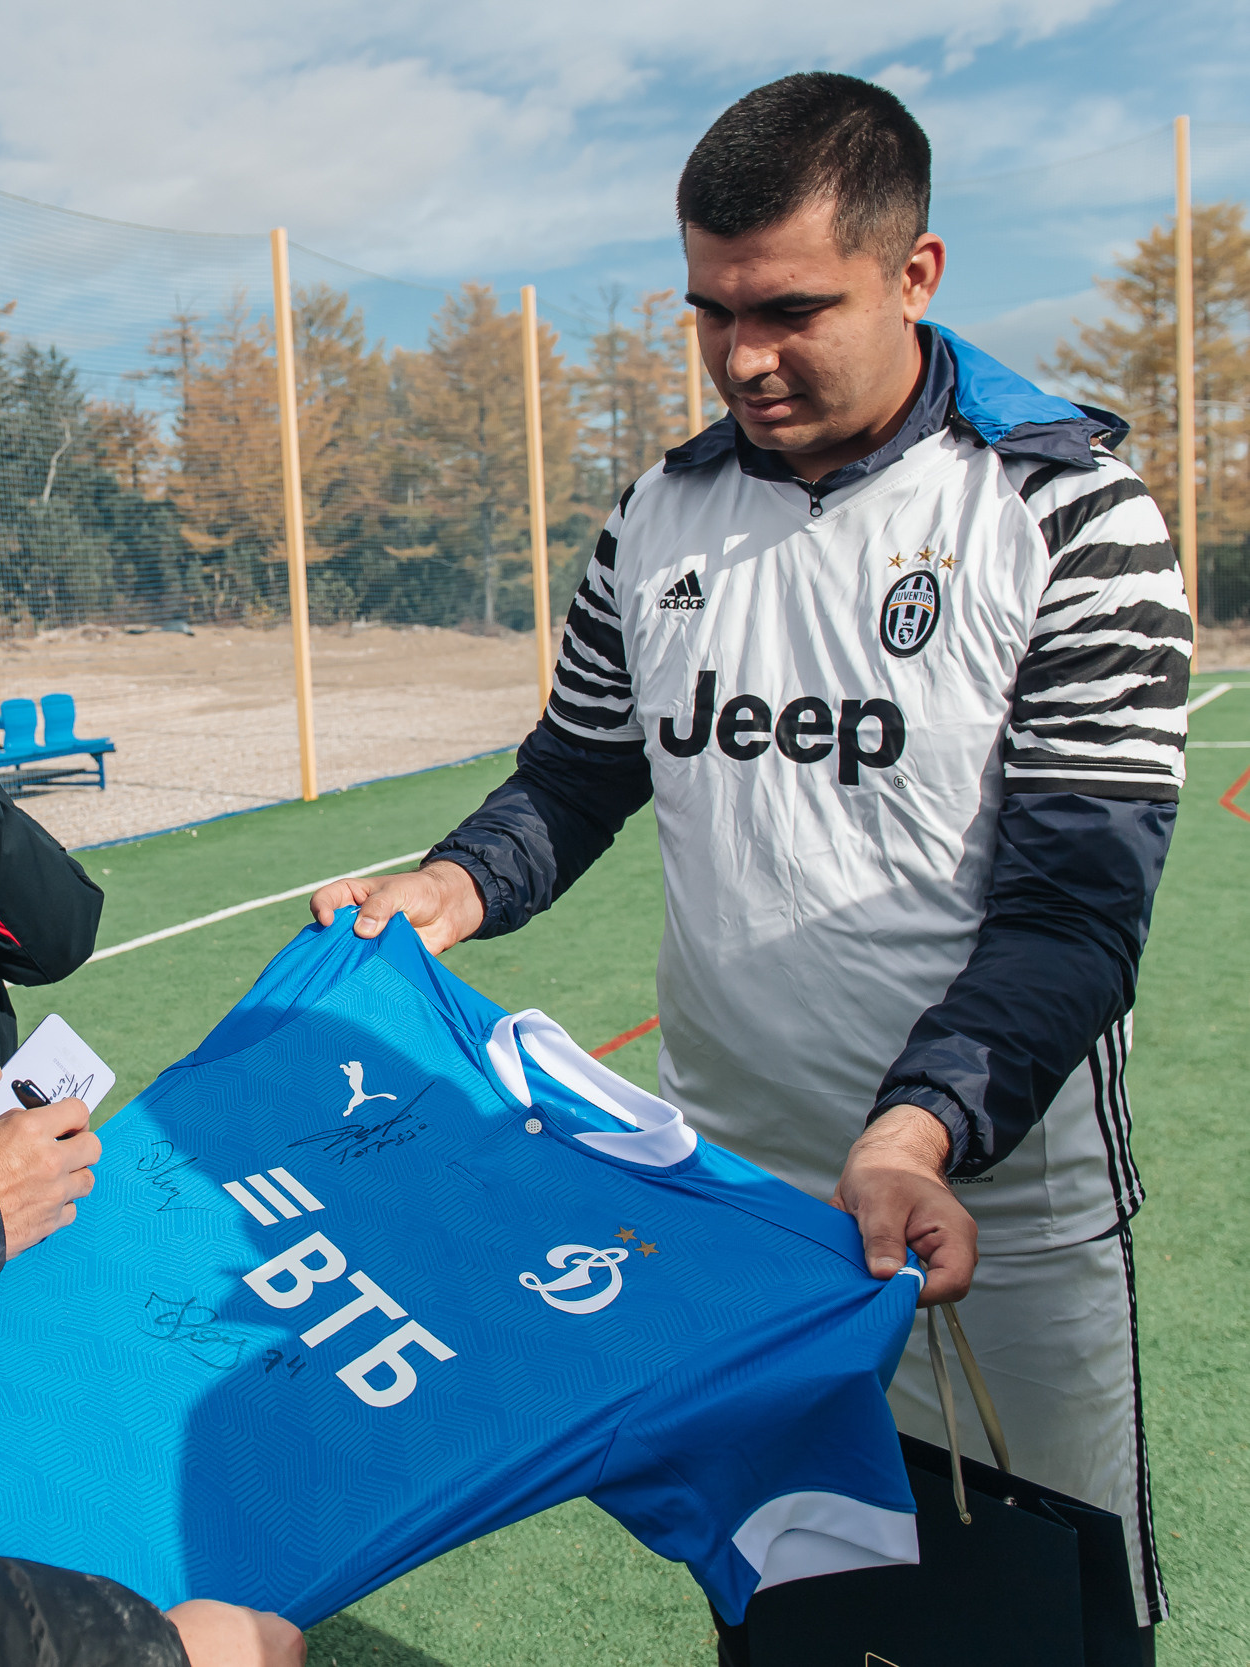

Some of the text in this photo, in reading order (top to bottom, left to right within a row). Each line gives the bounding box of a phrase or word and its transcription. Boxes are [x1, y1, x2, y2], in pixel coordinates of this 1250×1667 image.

[660, 595, 706, 610] adidas
[893, 591, 934, 605] JUVENTUS
[659, 670, 906, 786] Jeep
[242, 1230, 458, 1408] ВТБ
